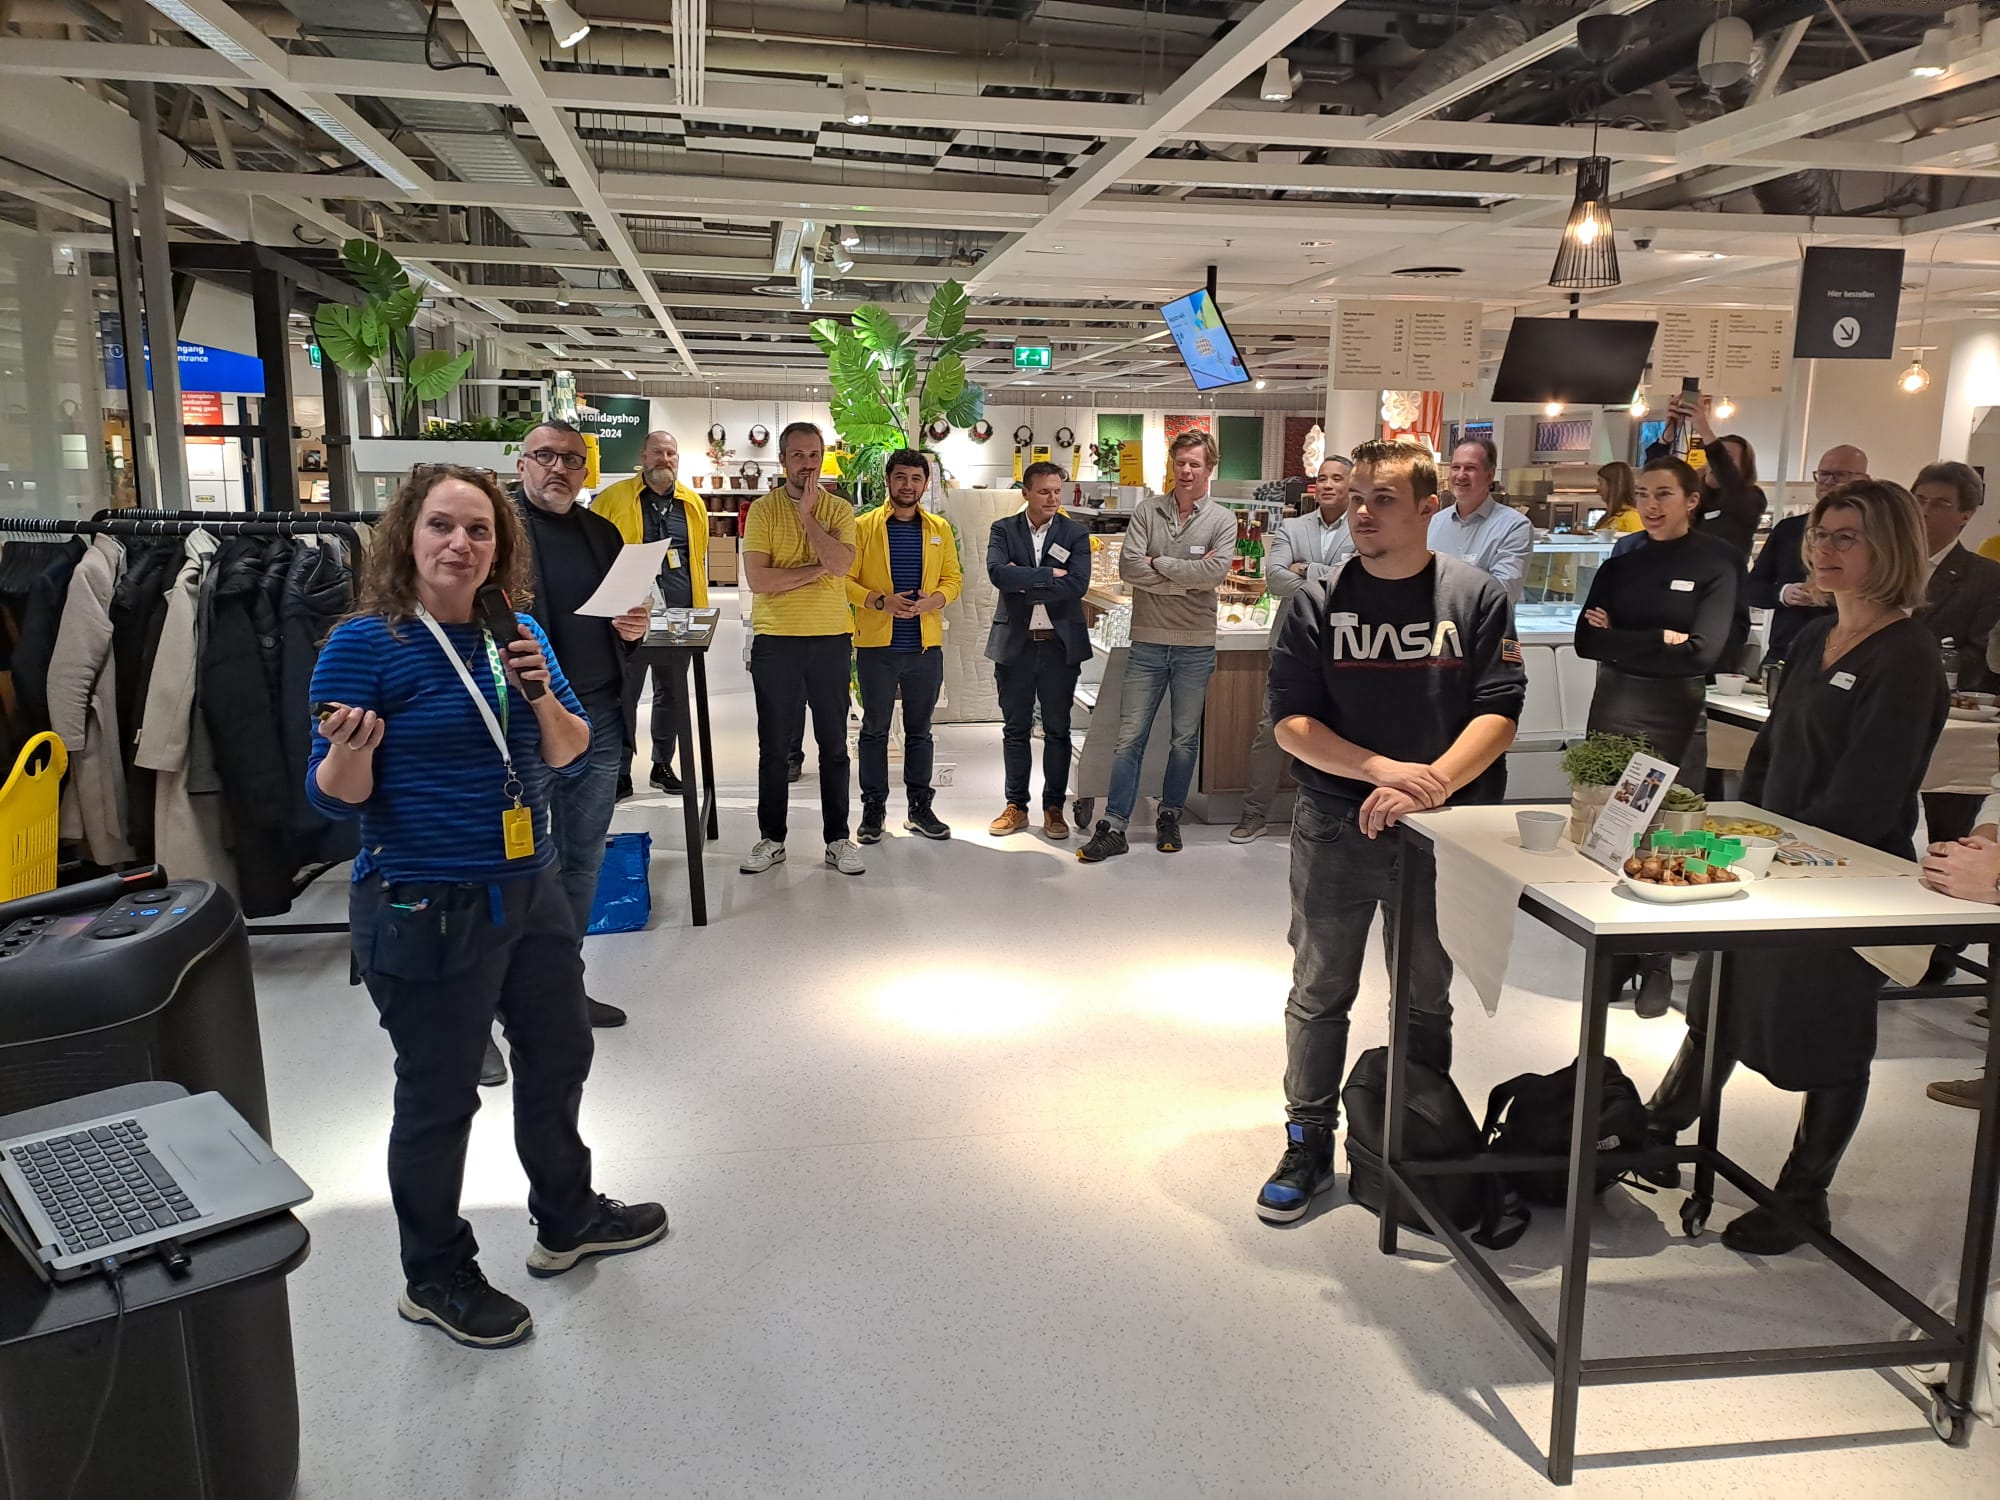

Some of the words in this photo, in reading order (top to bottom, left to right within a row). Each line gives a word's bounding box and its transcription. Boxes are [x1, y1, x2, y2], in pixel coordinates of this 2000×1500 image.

[1843, 290, 1875, 299] bestellen
[177, 345, 204, 355] ngang
[177, 354, 209, 362] ntrance
[580, 412, 641, 426] Holidayshop
[599, 428, 622, 438] 2024
[1333, 620, 1464, 660] NASA
